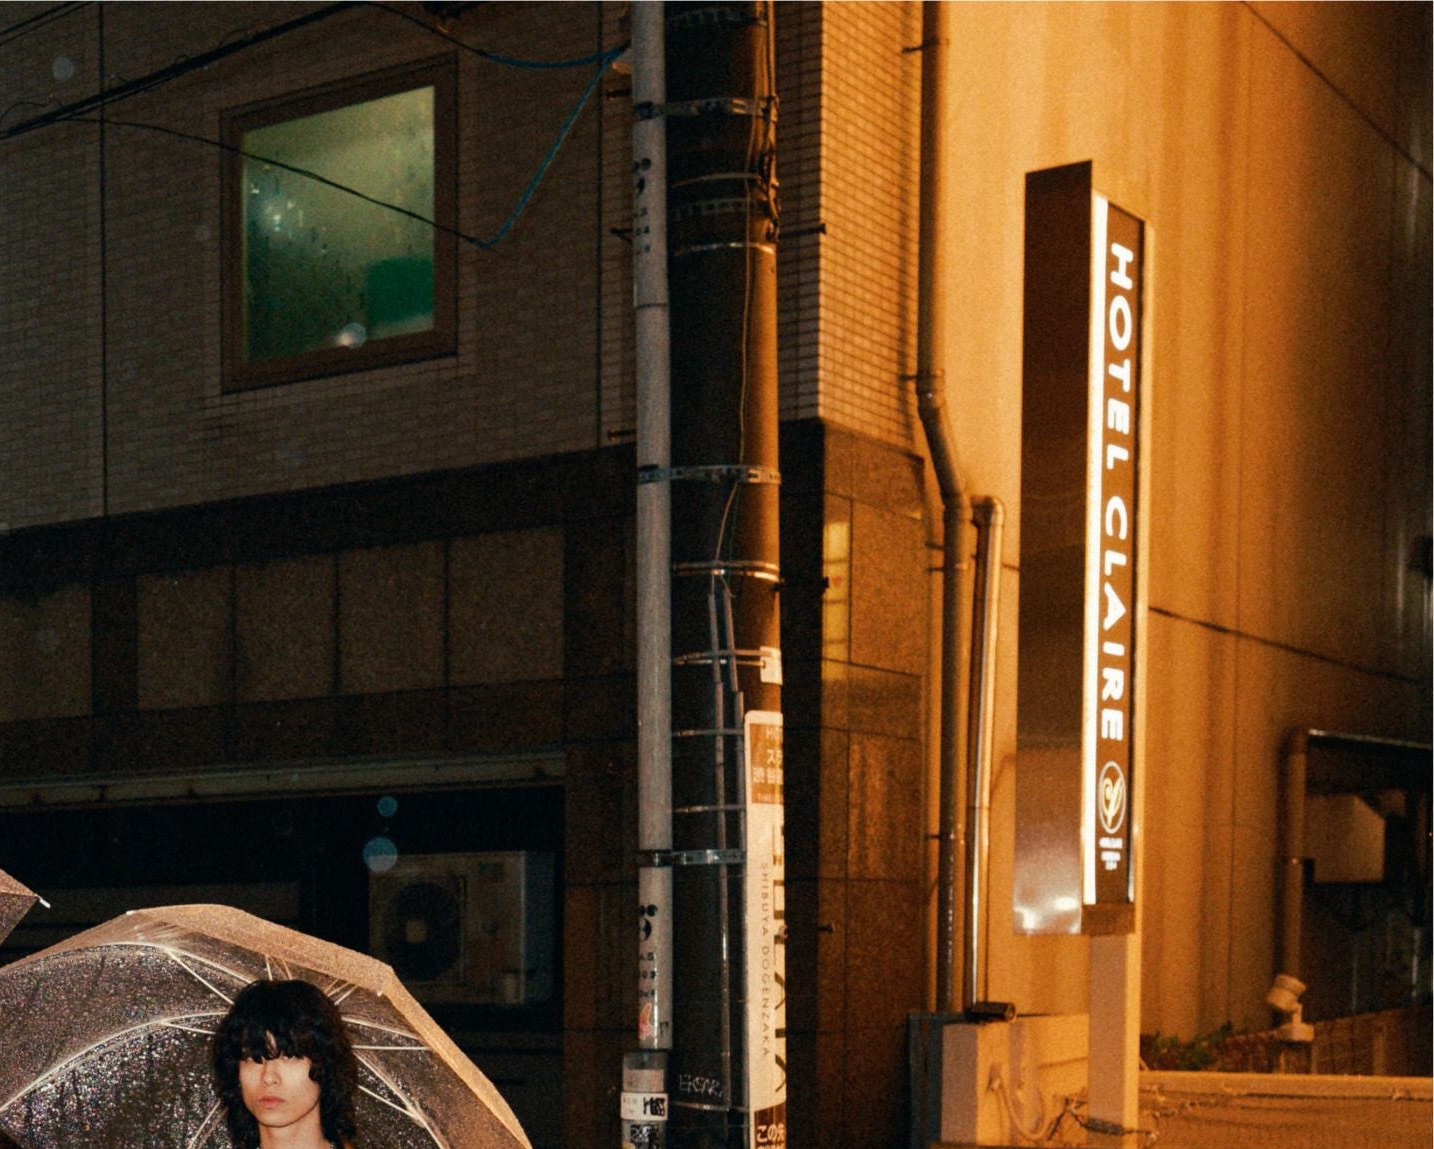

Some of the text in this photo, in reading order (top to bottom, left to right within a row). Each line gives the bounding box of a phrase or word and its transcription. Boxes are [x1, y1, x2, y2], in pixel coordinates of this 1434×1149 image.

[1101, 242, 1133, 741] HOTEL CLAIRE
[761, 862, 771, 936] SHIBUYA
